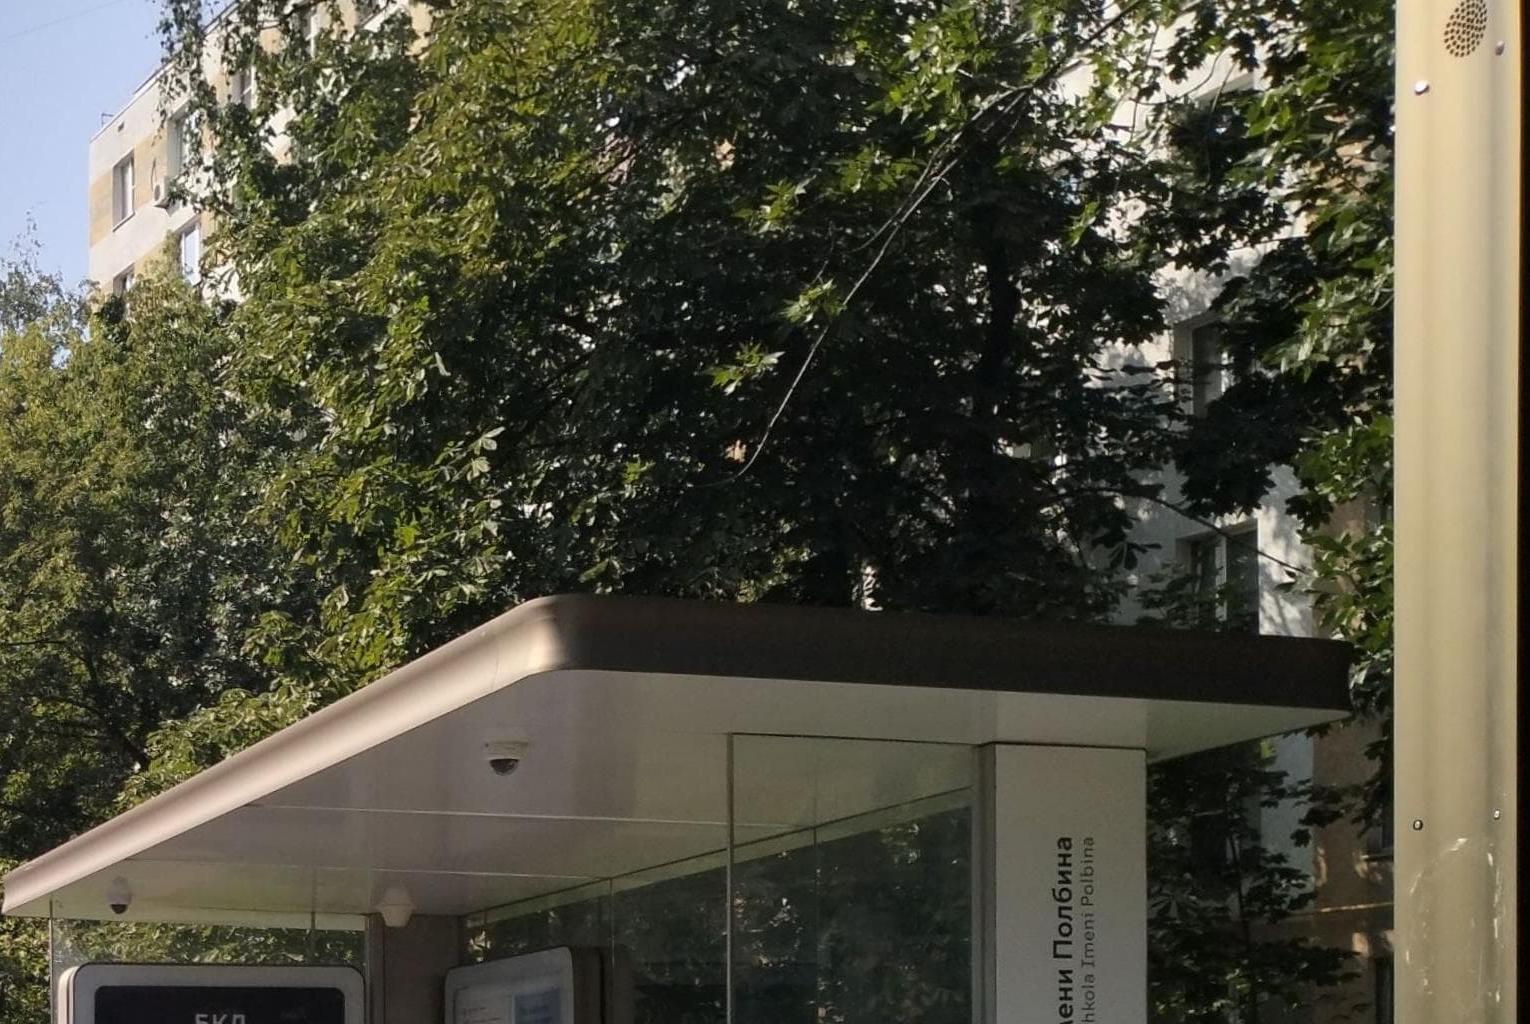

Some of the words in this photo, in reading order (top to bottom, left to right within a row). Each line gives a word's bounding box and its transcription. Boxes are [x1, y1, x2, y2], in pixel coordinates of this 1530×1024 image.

[1051, 837, 1073, 960] Полбина
[1079, 837, 1094, 906] Polbina
[1080, 913, 1095, 967] Imeni
